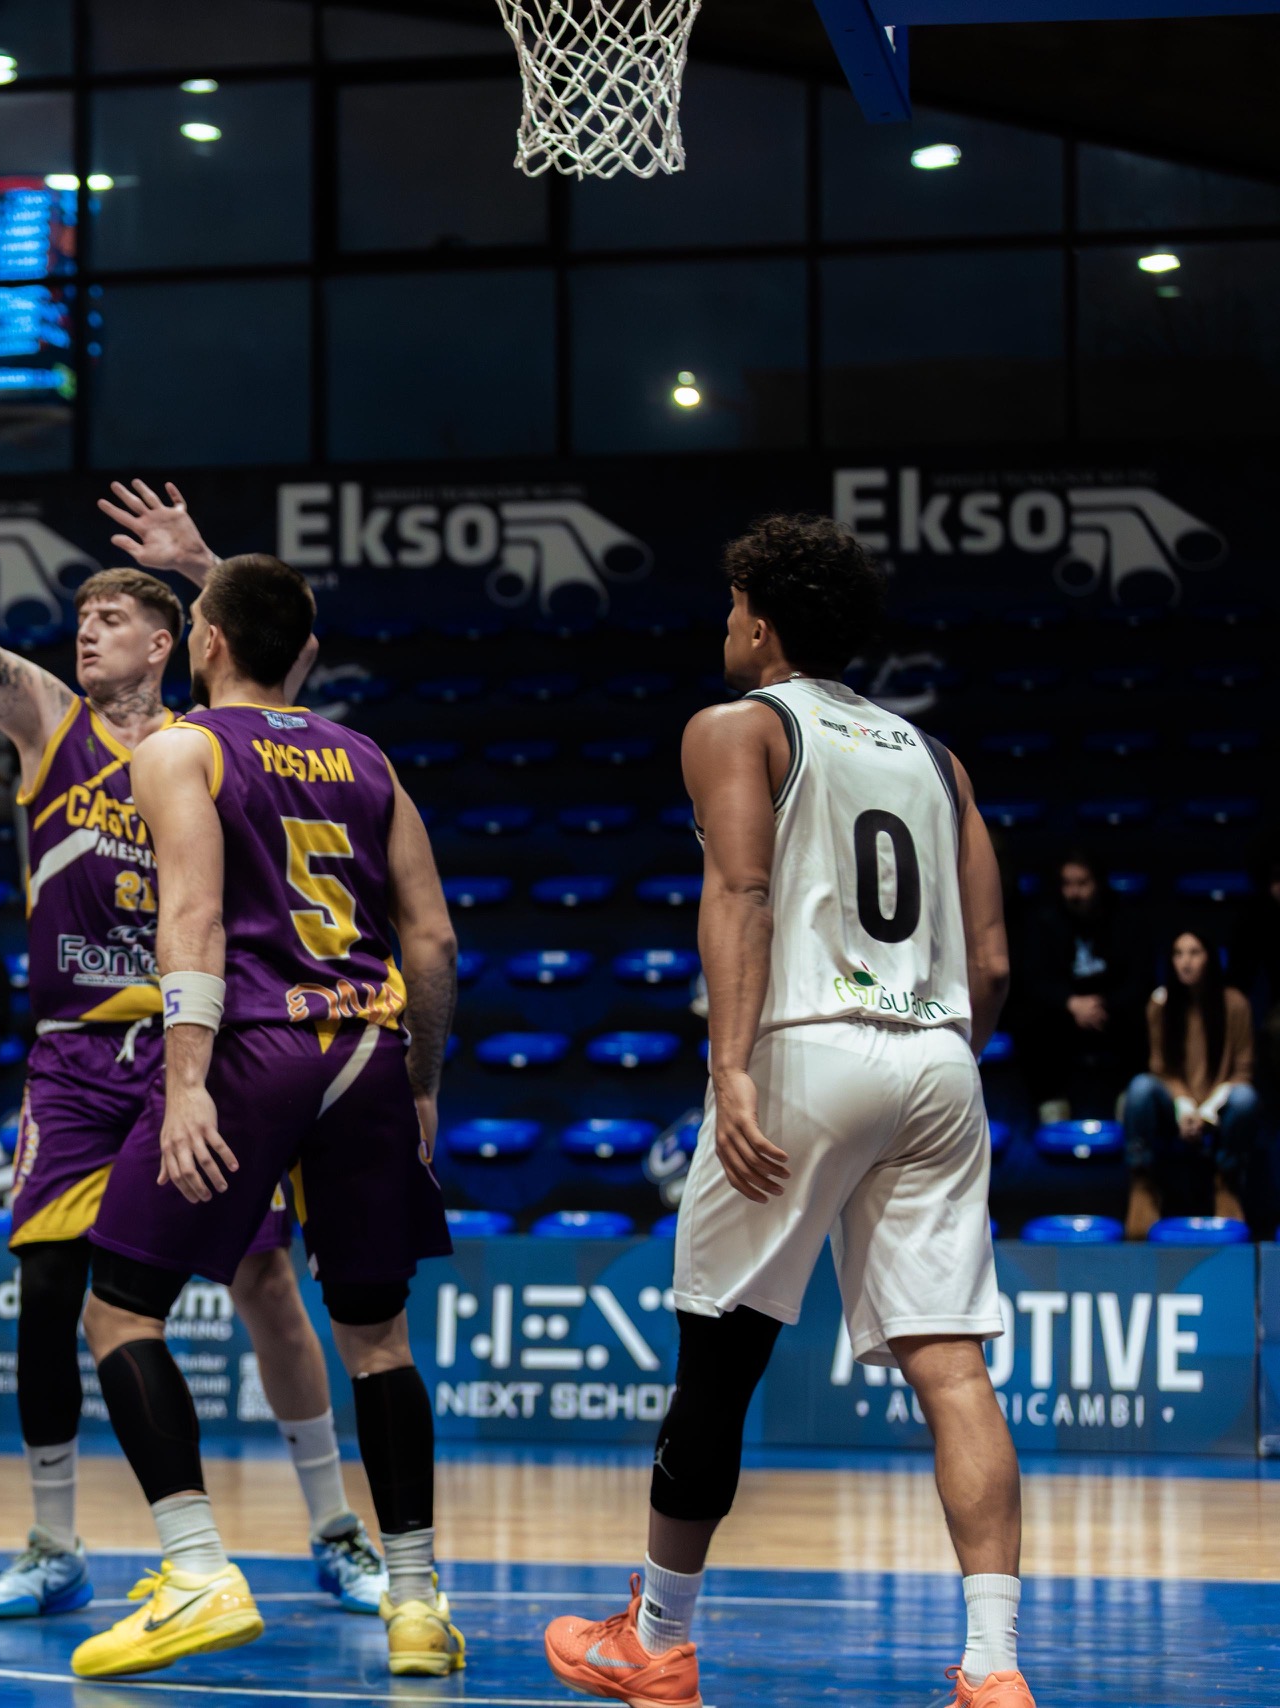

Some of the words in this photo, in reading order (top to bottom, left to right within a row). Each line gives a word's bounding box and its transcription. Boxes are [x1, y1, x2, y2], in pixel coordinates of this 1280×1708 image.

[276, 481, 501, 569] Ekso
[832, 466, 1067, 556] Ekso
[281, 816, 362, 961] 5
[854, 808, 922, 943] 0
[436, 1382, 543, 1418] NEXT
[549, 1383, 677, 1421] SCHO
